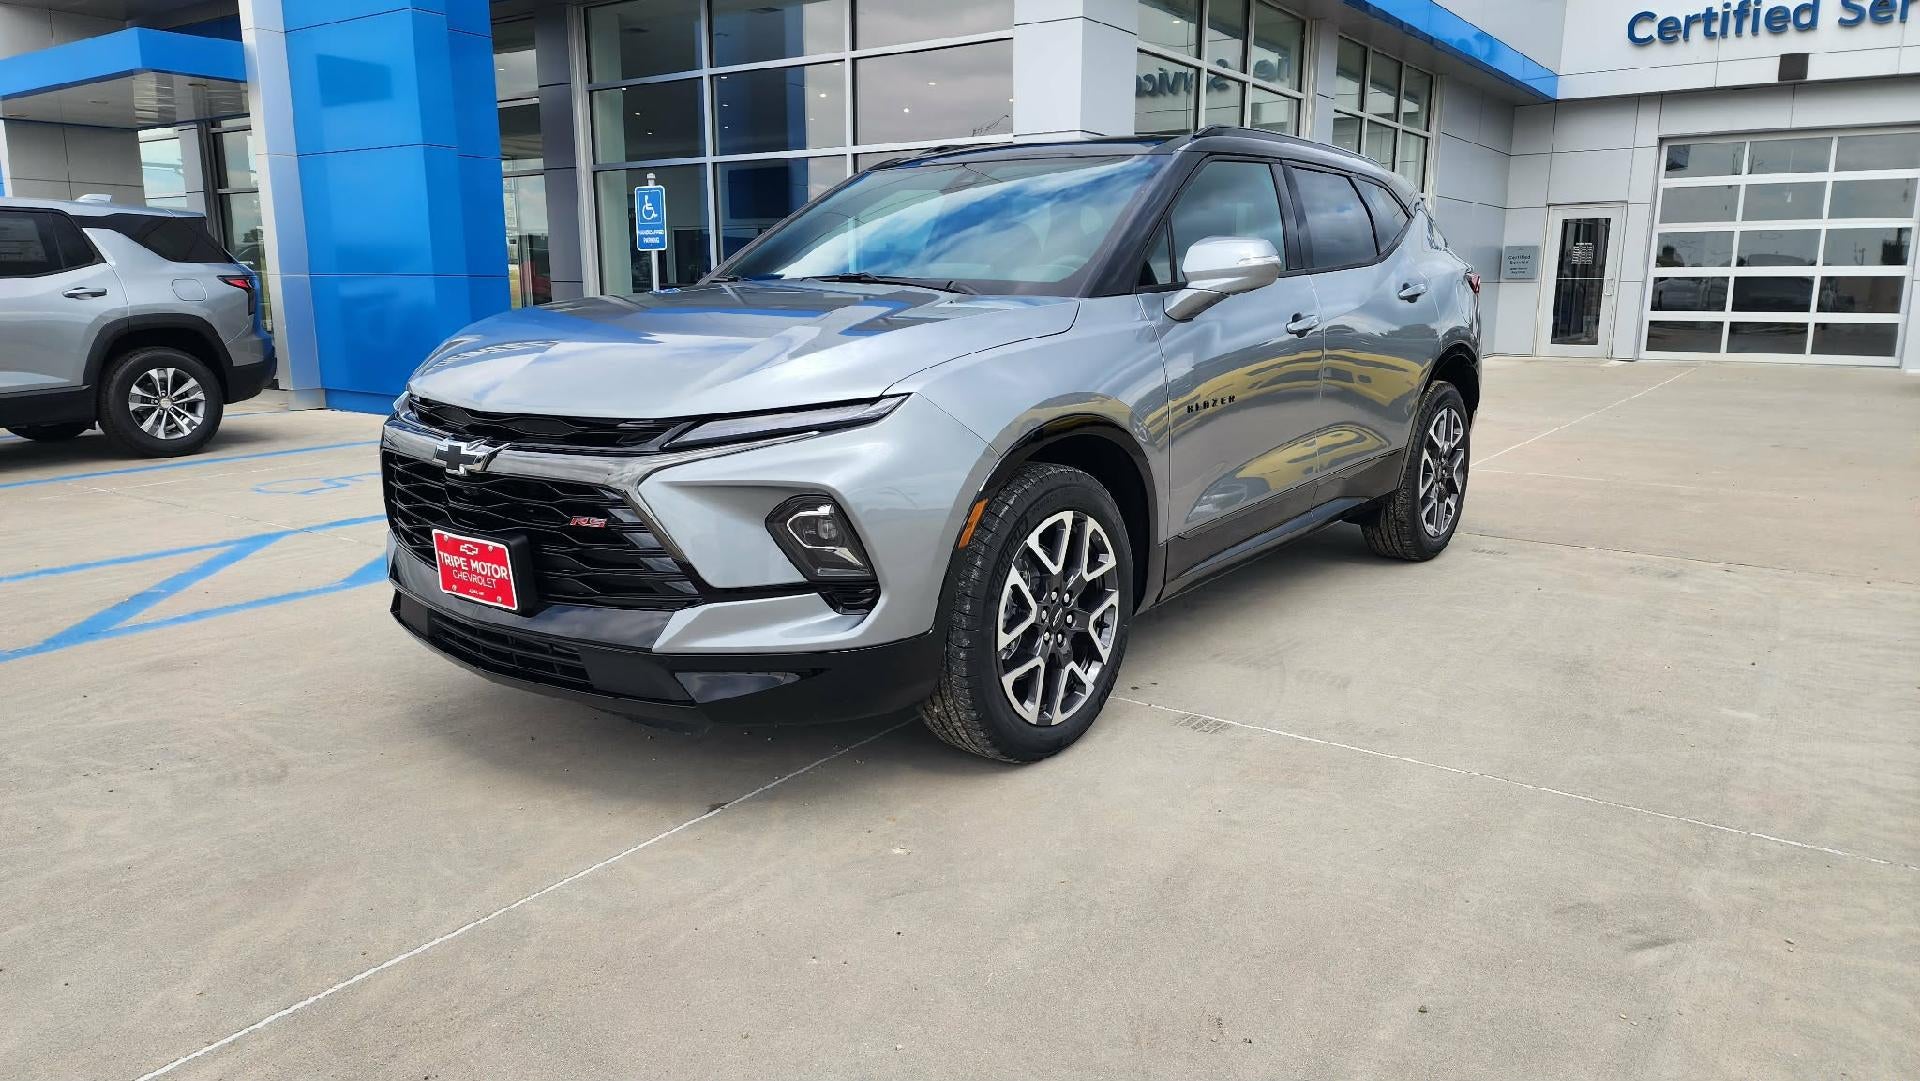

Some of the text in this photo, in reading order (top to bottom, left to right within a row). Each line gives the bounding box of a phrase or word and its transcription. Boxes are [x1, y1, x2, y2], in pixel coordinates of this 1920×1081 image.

[1628, 0, 1819, 46] Certified
[1186, 395, 1236, 413] BLAZER
[570, 515, 607, 528] RS
[439, 550, 509, 581] TRIPE MOTOR
[452, 569, 497, 589] CHEVROLET
